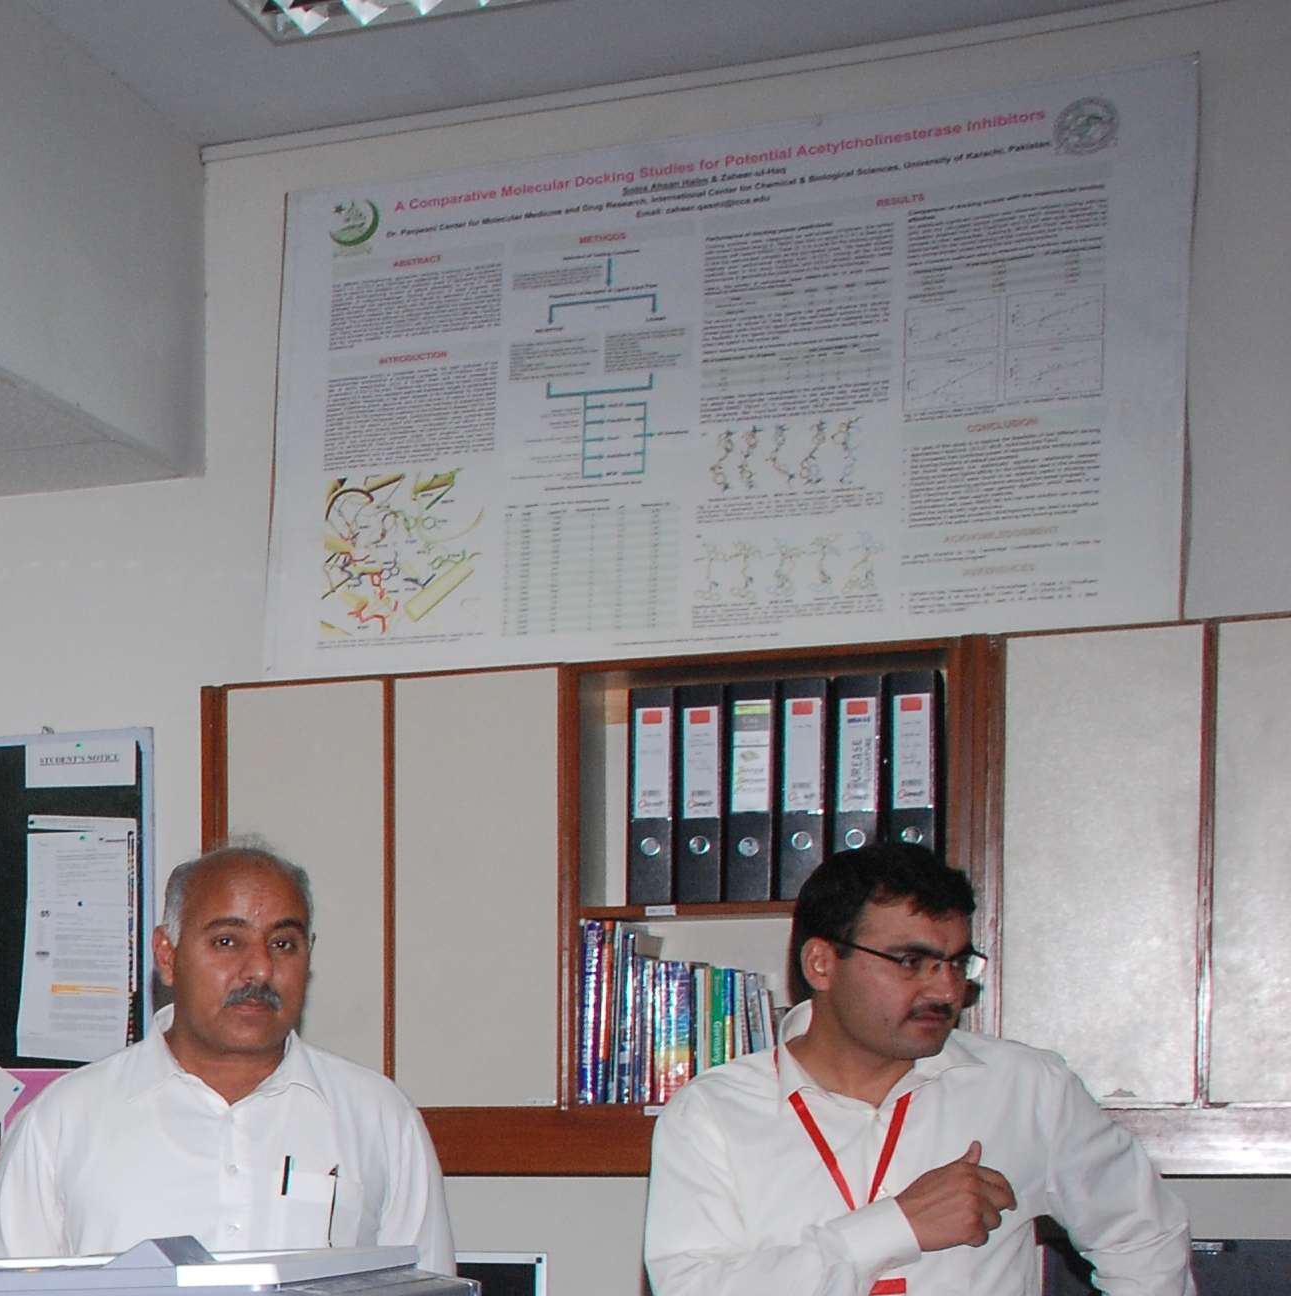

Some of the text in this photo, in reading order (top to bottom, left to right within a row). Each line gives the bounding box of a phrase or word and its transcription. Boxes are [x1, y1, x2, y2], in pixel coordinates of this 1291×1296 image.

[394, 108, 1046, 212] A Comparative Molecular Docking Studies for Potential Acetylcholinesterase Inhibitors
[875, 193, 925, 208] RESULTS
[578, 231, 627, 245] METHODS
[392, 254, 442, 268] ABSTRACT
[87, 753, 119, 764] NOTICE
